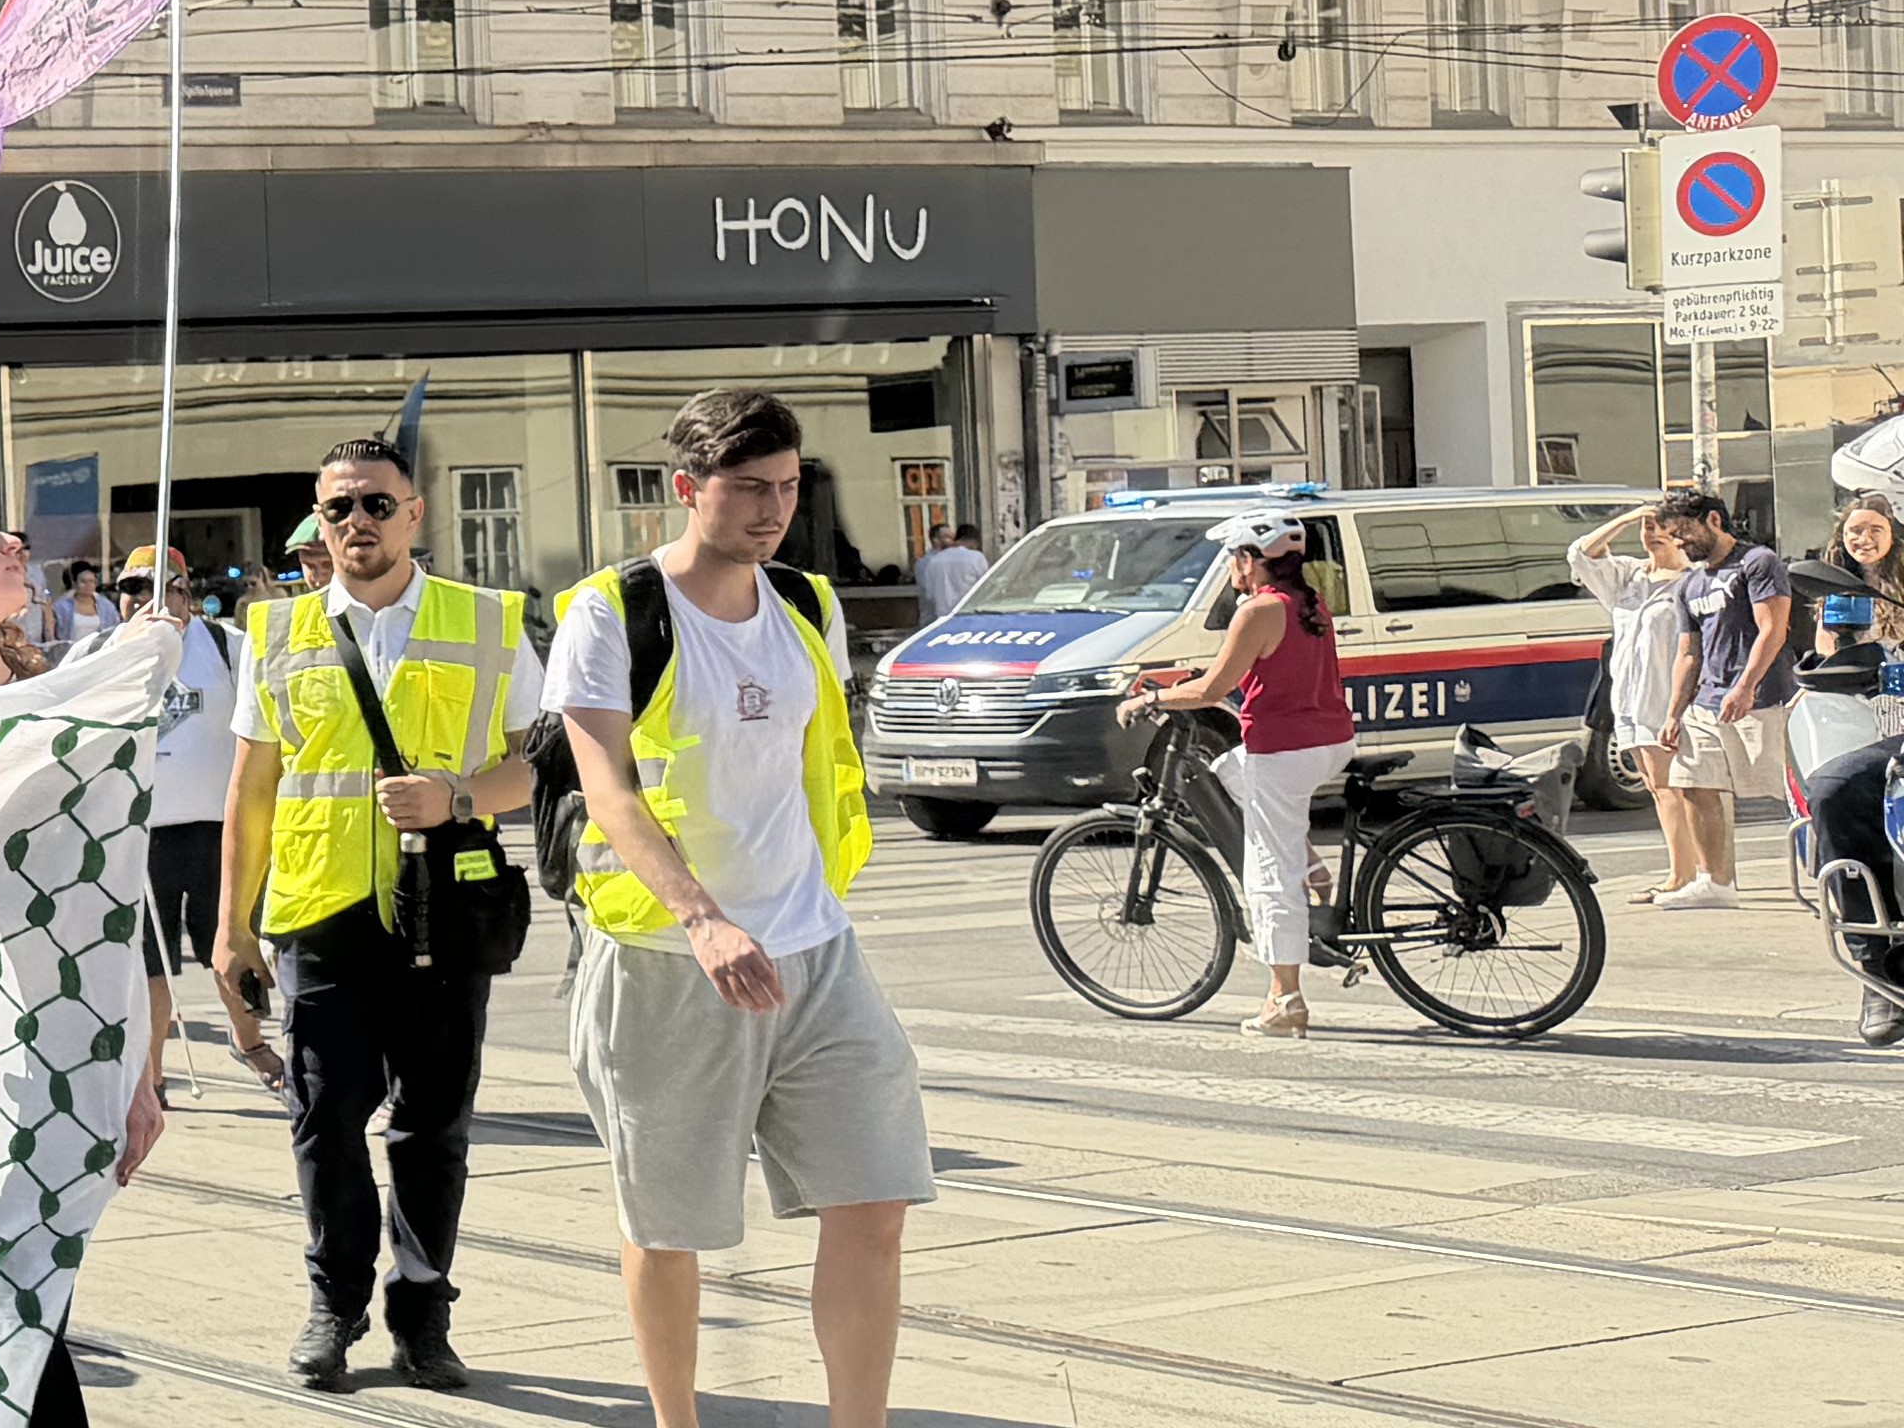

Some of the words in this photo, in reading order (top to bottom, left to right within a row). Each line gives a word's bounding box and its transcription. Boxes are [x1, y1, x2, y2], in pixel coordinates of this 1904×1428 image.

[1685, 104, 1753, 129] ANFANG
[715, 194, 927, 265] HONU
[1670, 247, 1772, 267] Kurzparkzone
[43, 274, 93, 286] FACTORY
[1739, 305, 1746, 318] 2
[1749, 305, 1772, 316] Std.
[927, 631, 1056, 647] POLIZEI
